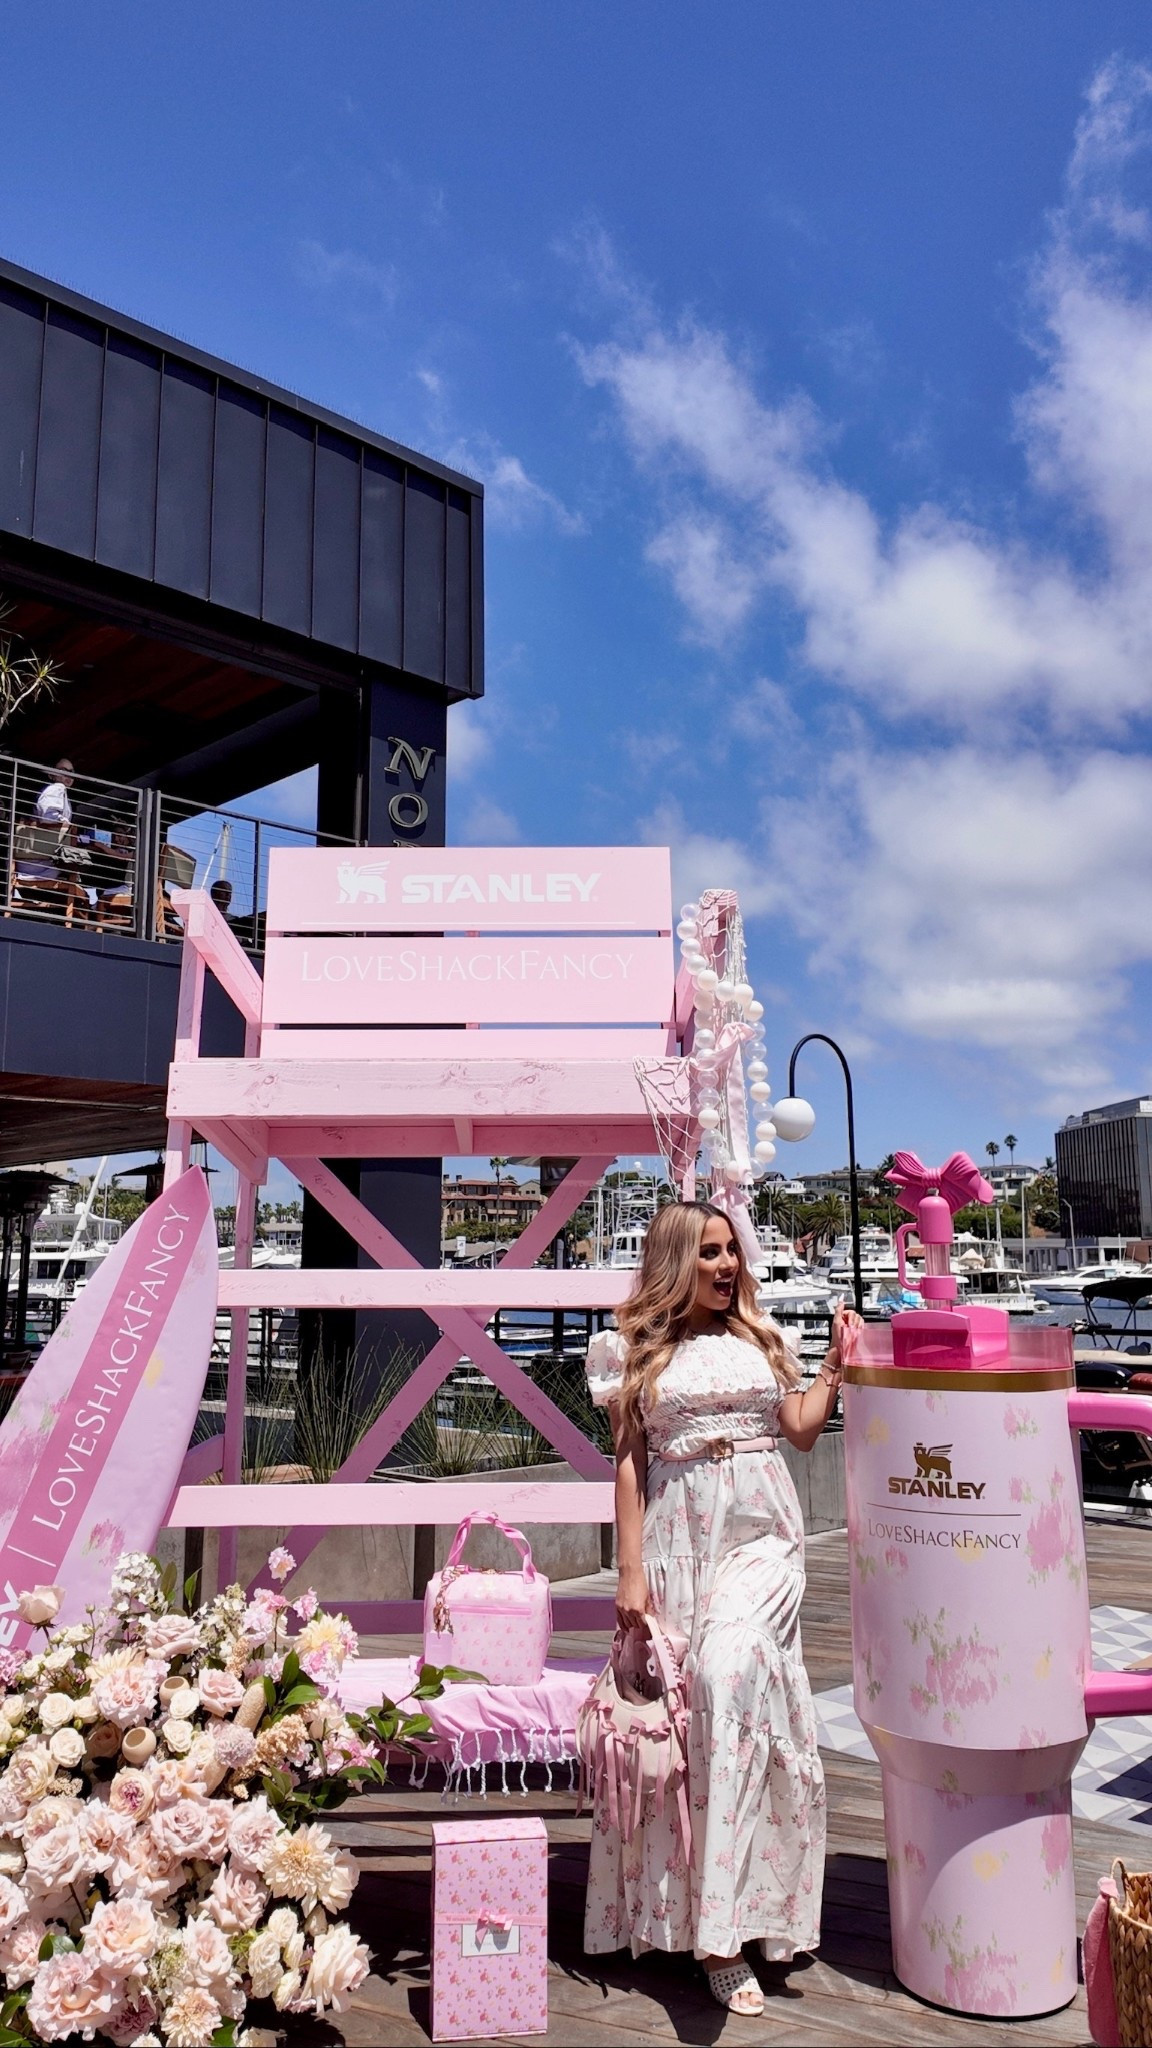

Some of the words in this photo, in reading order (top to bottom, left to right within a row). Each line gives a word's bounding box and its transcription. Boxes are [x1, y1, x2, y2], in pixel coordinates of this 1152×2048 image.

[384, 736, 436, 847] NO
[402, 873, 602, 903] STANLEY
[888, 1476, 986, 1499] STANLEY
